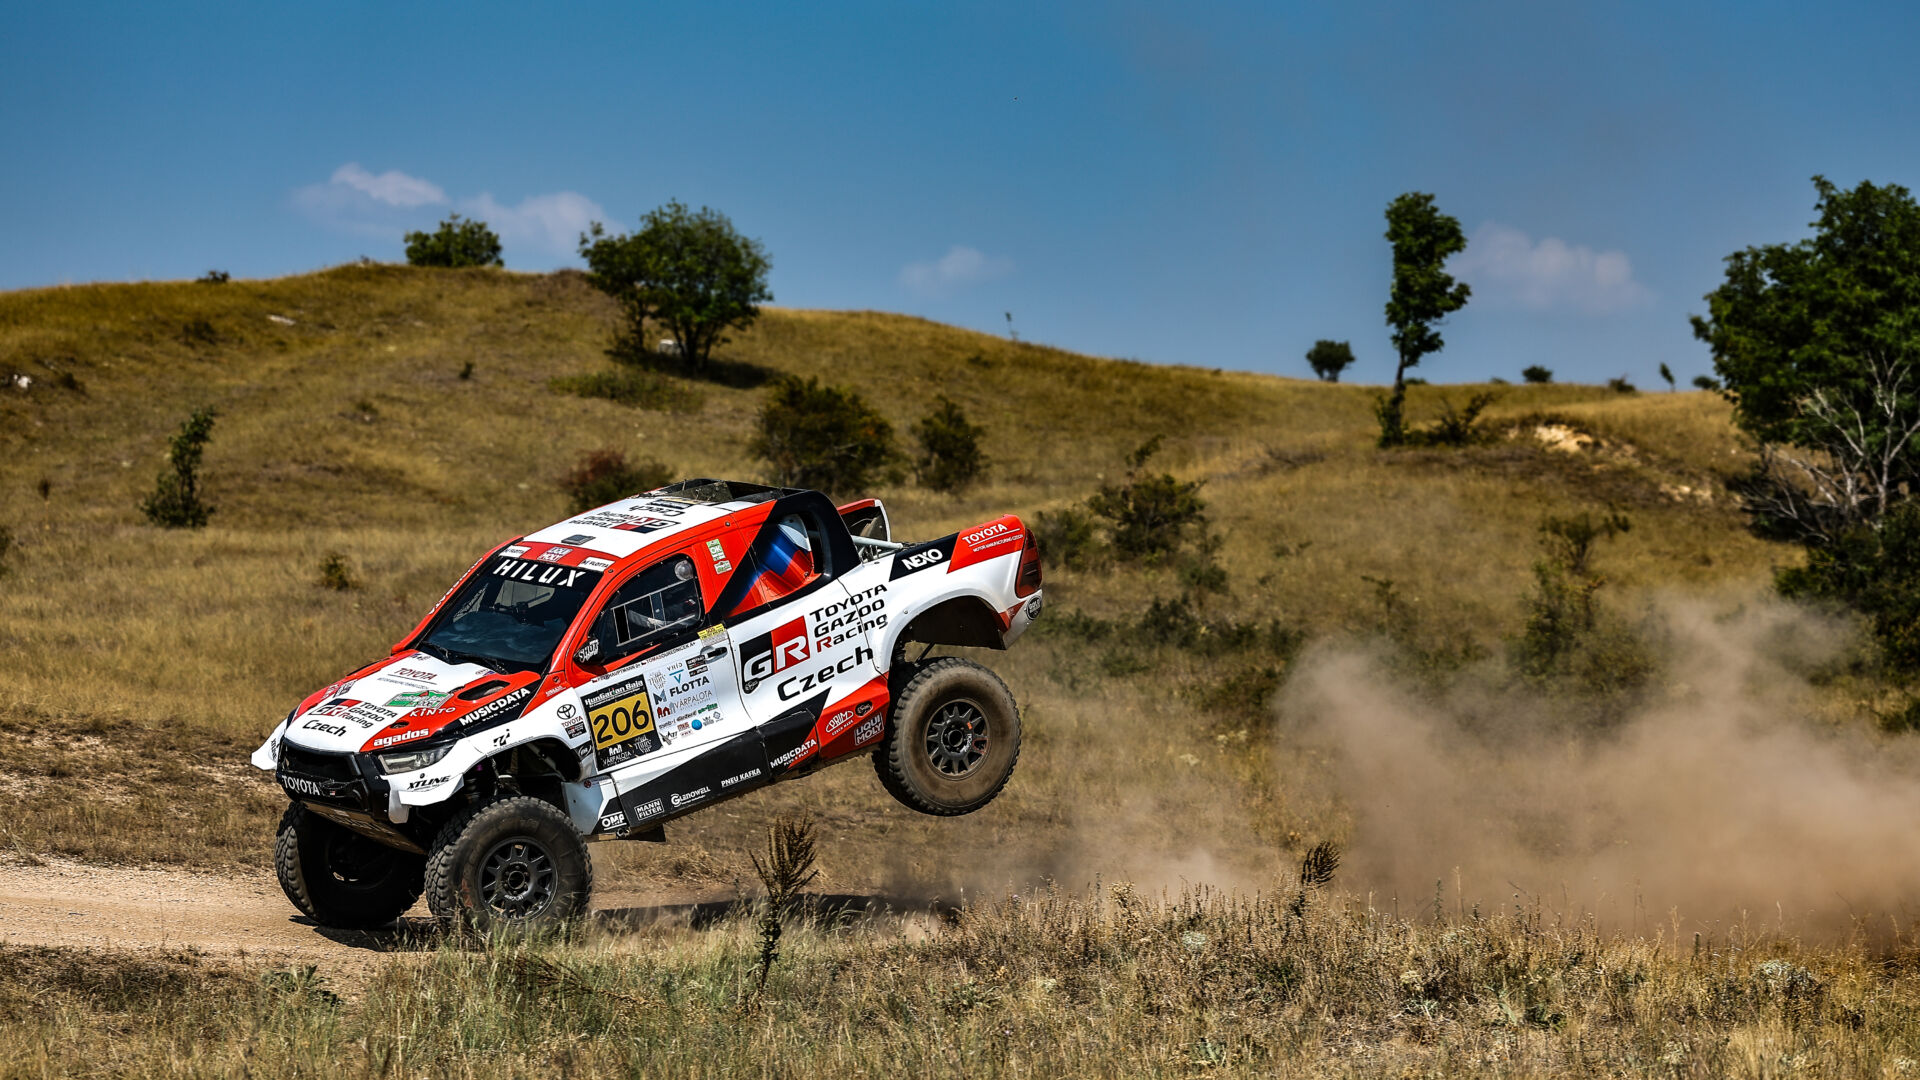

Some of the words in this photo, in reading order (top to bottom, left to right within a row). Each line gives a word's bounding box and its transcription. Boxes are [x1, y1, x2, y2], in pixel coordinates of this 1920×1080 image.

[962, 523, 1008, 544] TOYOTA
[901, 548, 943, 570] NEXO
[493, 559, 586, 587] HILUX
[809, 584, 887, 622] TOYOTA
[814, 599, 885, 638] GAZOO
[816, 614, 888, 653] Racing
[743, 635, 809, 682] GR
[394, 667, 437, 680] TOYOTA
[778, 646, 873, 701] Czech
[670, 676, 710, 697] FLOTTA
[349, 707, 385, 722] GAZOO
[360, 702, 398, 718] TOYOTA
[409, 707, 456, 717] KINTO
[459, 687, 530, 726] MUSICDATA
[302, 719, 347, 737] Czech
[339, 712, 373, 729] Racing
[561, 716, 583, 727] TOYOTA
[593, 700, 649, 744] 206
[856, 714, 881, 736] LIQUI
[373, 728, 429, 747] agados
[857, 723, 882, 744] MOLY
[770, 739, 817, 768] MUSICDATA
[282, 775, 321, 796] TOYOTA
[407, 775, 451, 791] XTLINE
[721, 775, 739, 788] PNEU
[739, 768, 761, 782] KAFKA
[637, 801, 660, 813] MANN
[639, 806, 662, 818] FILTER
[602, 814, 625, 827] OMP
